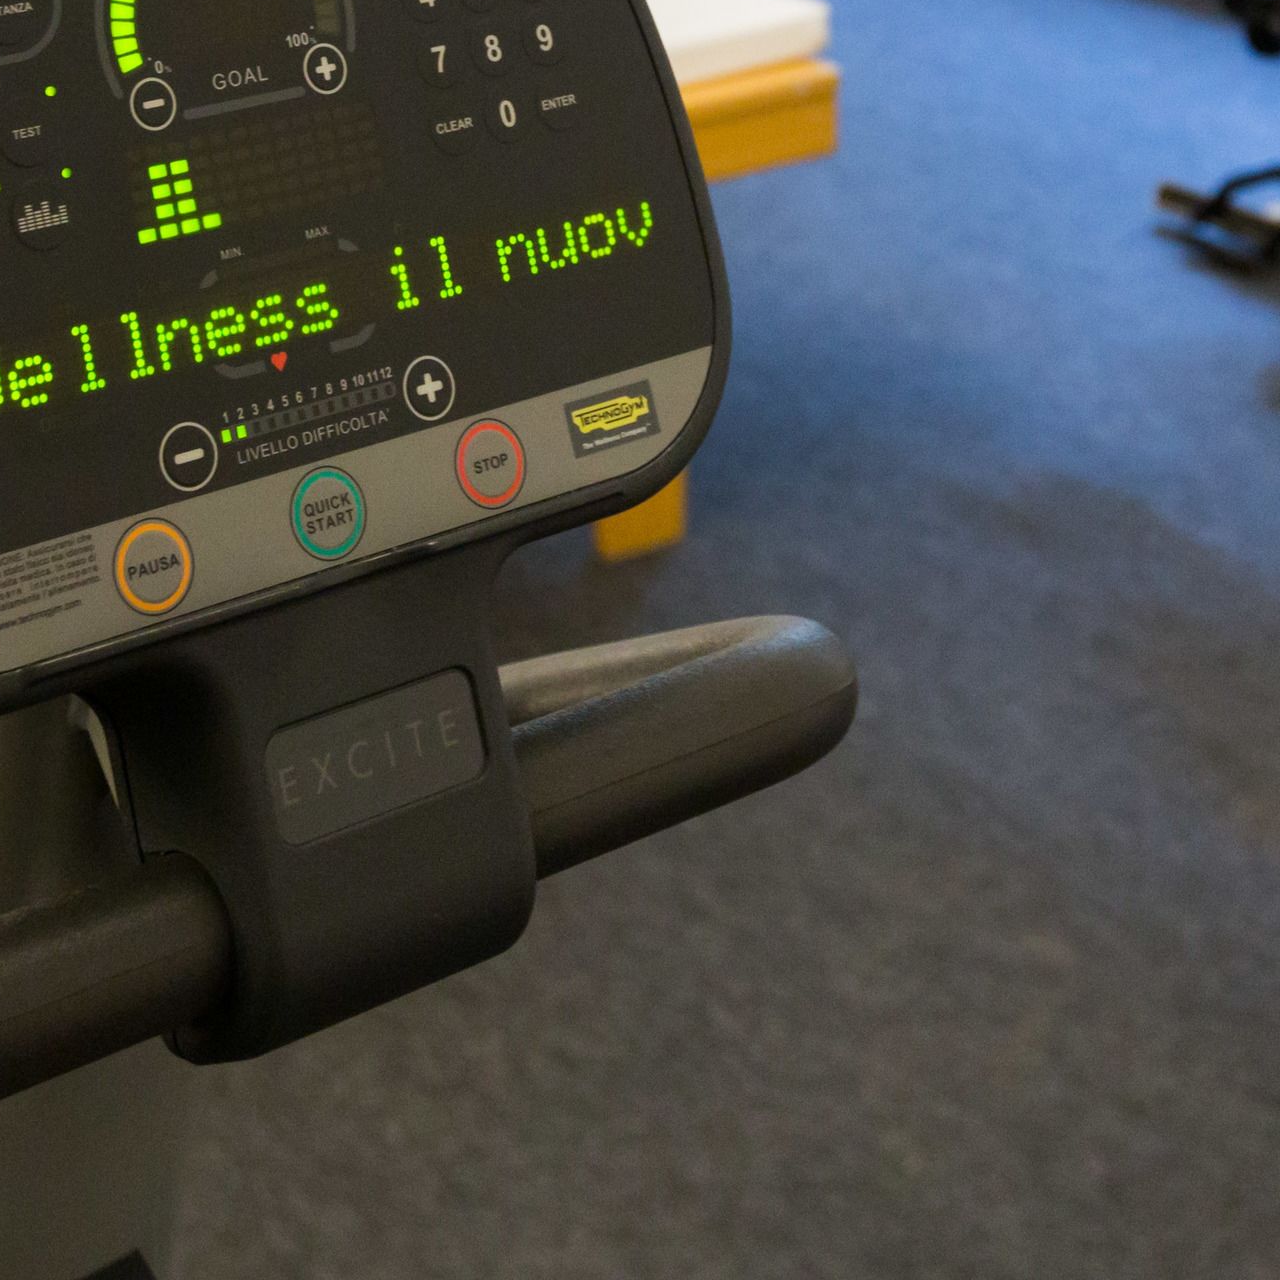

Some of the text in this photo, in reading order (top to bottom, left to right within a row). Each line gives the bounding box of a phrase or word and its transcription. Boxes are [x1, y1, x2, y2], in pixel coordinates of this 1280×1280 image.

[285, 32, 317, 49] 100%
[430, 24, 554, 73] 7 8 9
[212, 66, 269, 90] GOAL
[435, 94, 578, 135] CLEAR 0 ENTER
[11, 125, 42, 140] TEST
[389, 235, 463, 310] il
[495, 201, 653, 283] nuov
[222, 366, 393, 424] 1 2 3 4 5 6 7 8 9 10 11 12
[237, 408, 390, 465] LIVELLO DIFFICOLTA'
[473, 453, 508, 474] STOP
[304, 492, 353, 519] QUICK
[306, 509, 355, 535] START
[127, 553, 181, 580] PAUSA
[279, 708, 461, 806] EXCITE
